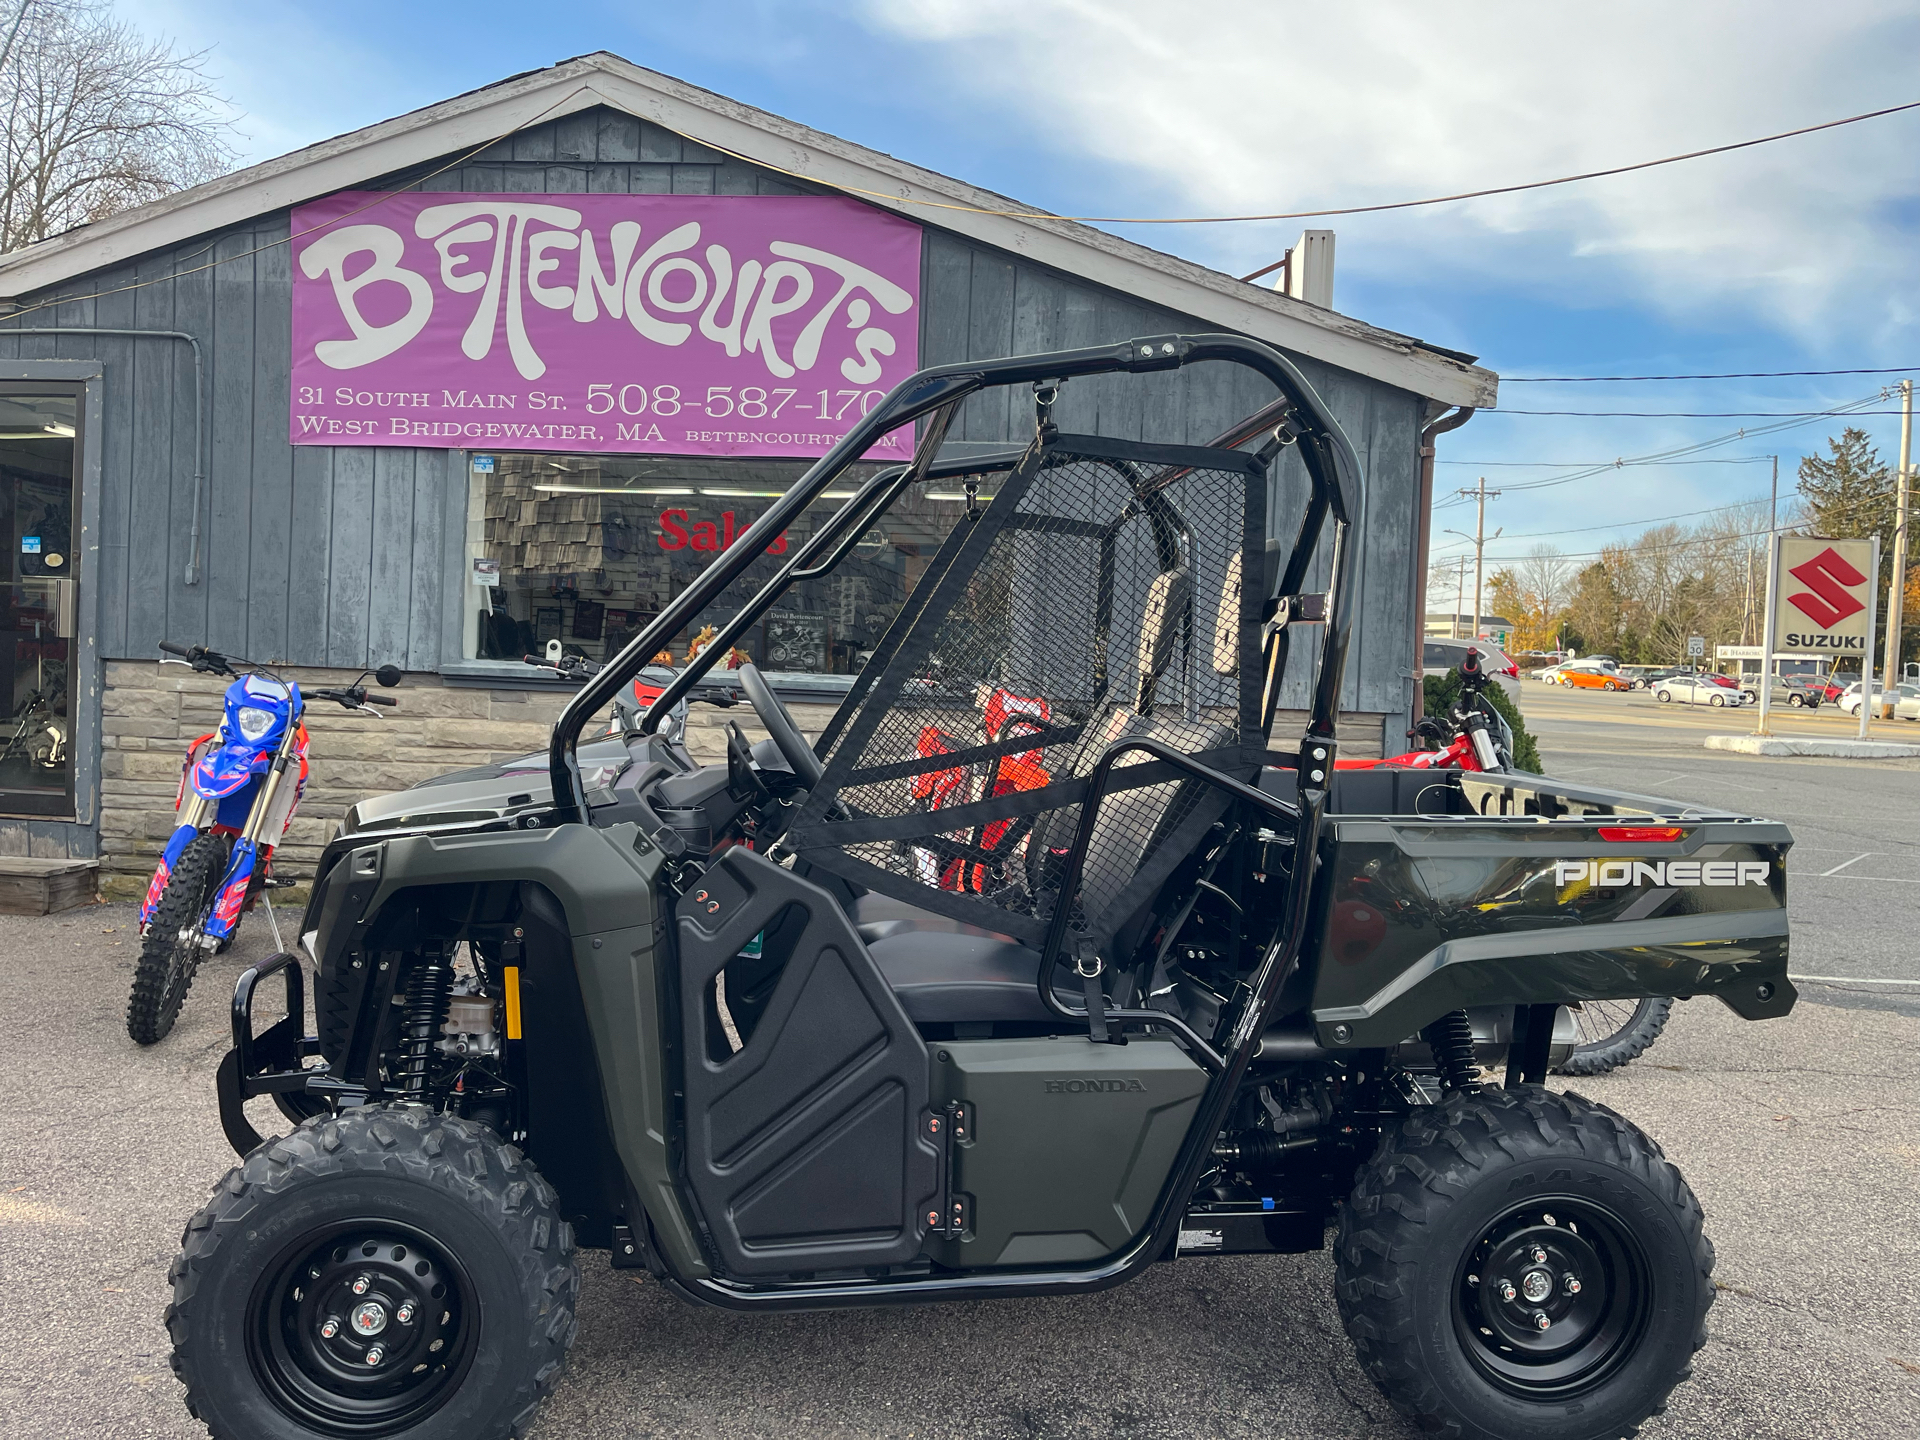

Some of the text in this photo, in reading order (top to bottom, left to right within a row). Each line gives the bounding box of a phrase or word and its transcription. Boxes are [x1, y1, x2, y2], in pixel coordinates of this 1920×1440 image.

[298, 386, 325, 406] 31
[335, 387, 430, 408] SOUTH
[441, 389, 518, 410] MAIN
[527, 391, 567, 411] ST.
[296, 415, 379, 435] WEST
[388, 417, 604, 443] BRIDGEWATER,
[615, 422, 667, 442] MA
[657, 508, 788, 555] Sals
[770, 612, 824, 621] David Bettencourt
[1689, 646, 1702, 655] 30
[1785, 633, 1866, 649] SUZUKI
[1555, 861, 1770, 887] PIONEER
[1043, 1078, 1148, 1094] HONDA
[1505, 1168, 1673, 1244] MAXXIS
